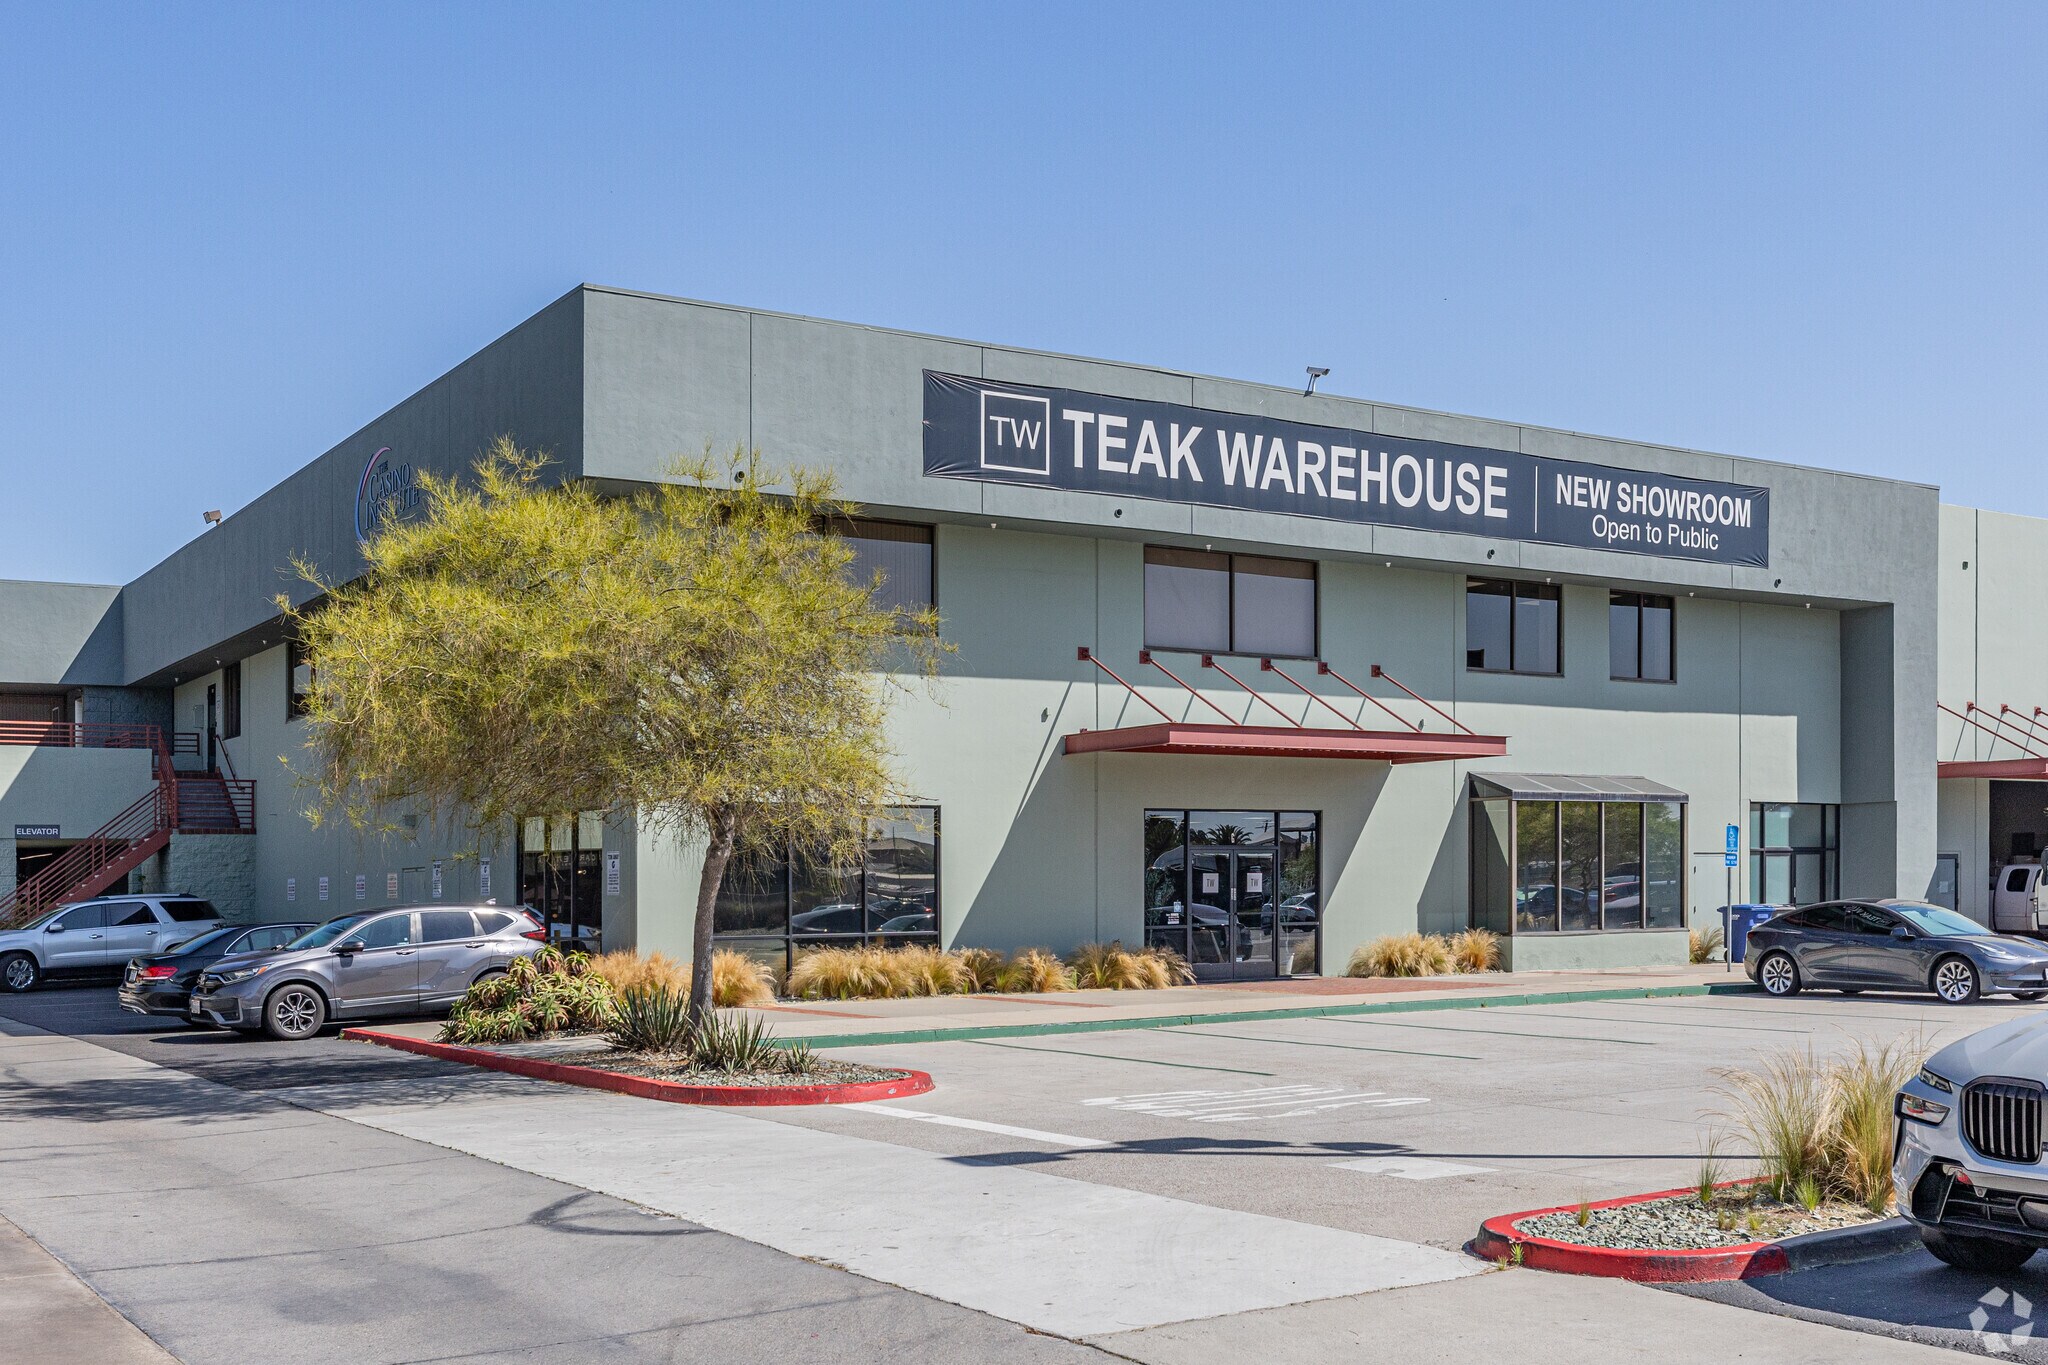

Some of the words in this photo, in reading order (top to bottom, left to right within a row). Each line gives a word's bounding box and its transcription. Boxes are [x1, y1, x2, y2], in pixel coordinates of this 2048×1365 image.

[989, 415, 1042, 450] TW
[369, 462, 411, 504] CASINO
[1063, 408, 1203, 483] TEAK
[1217, 430, 1508, 519] WAREHOUSE
[365, 485, 421, 530] INSUTE
[1556, 474, 1612, 510] NEW
[1616, 482, 1752, 528] SHOWROOM
[1592, 514, 1641, 544] Open
[1645, 523, 1662, 544] to
[1668, 524, 1720, 551] Public
